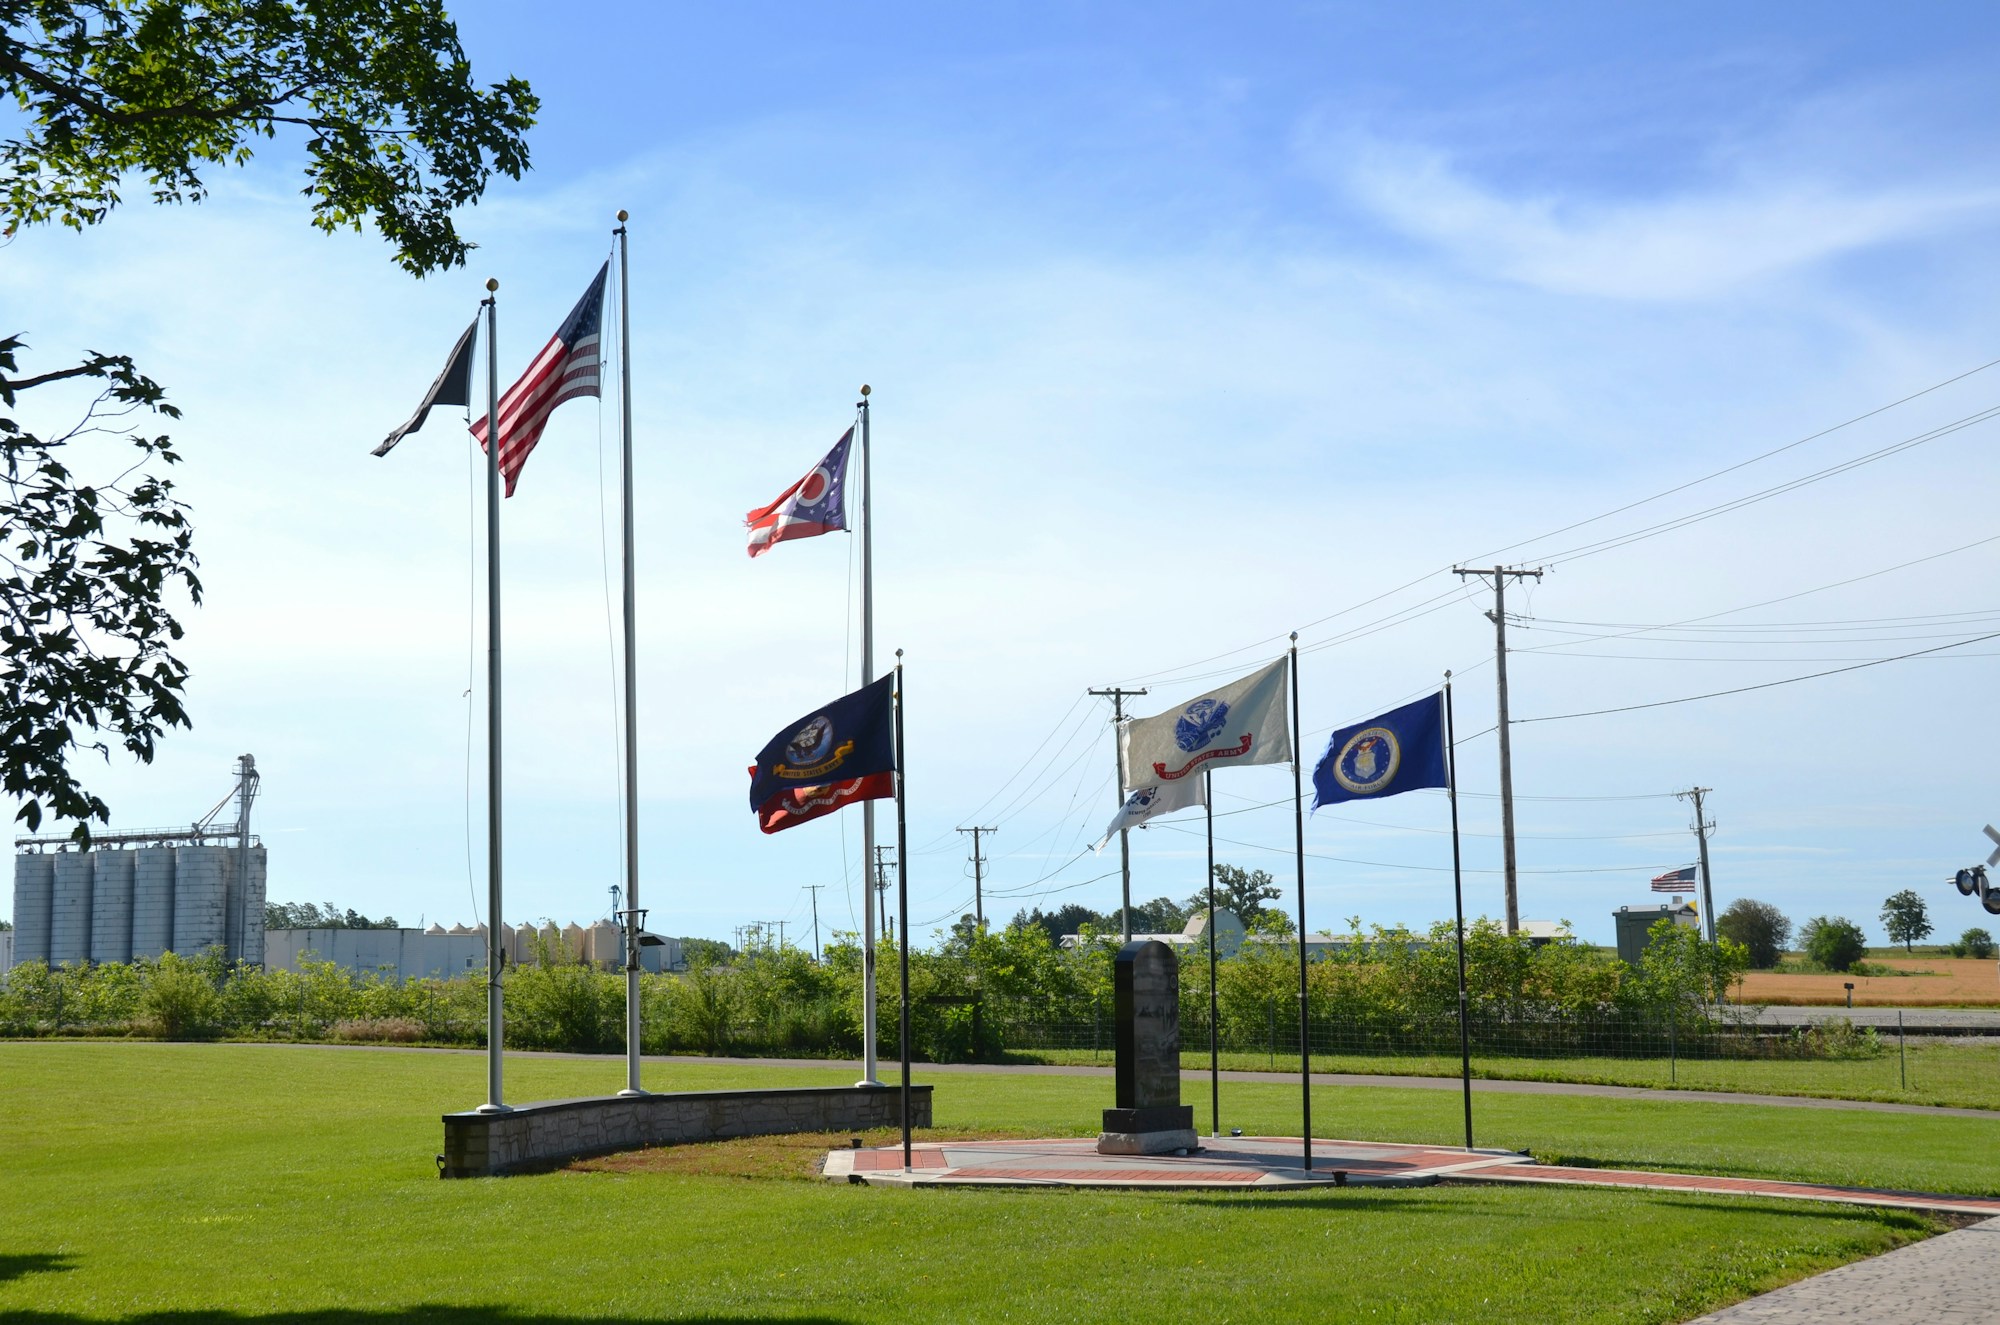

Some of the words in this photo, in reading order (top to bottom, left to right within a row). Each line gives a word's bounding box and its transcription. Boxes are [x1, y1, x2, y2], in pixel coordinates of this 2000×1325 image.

[1165, 766, 1190, 778] UNITED
[1190, 751, 1215, 766] STATES
[1217, 747, 1244, 756] ARMY
[803, 768, 822, 777] STATES
[1194, 763, 1209, 774] 1775
